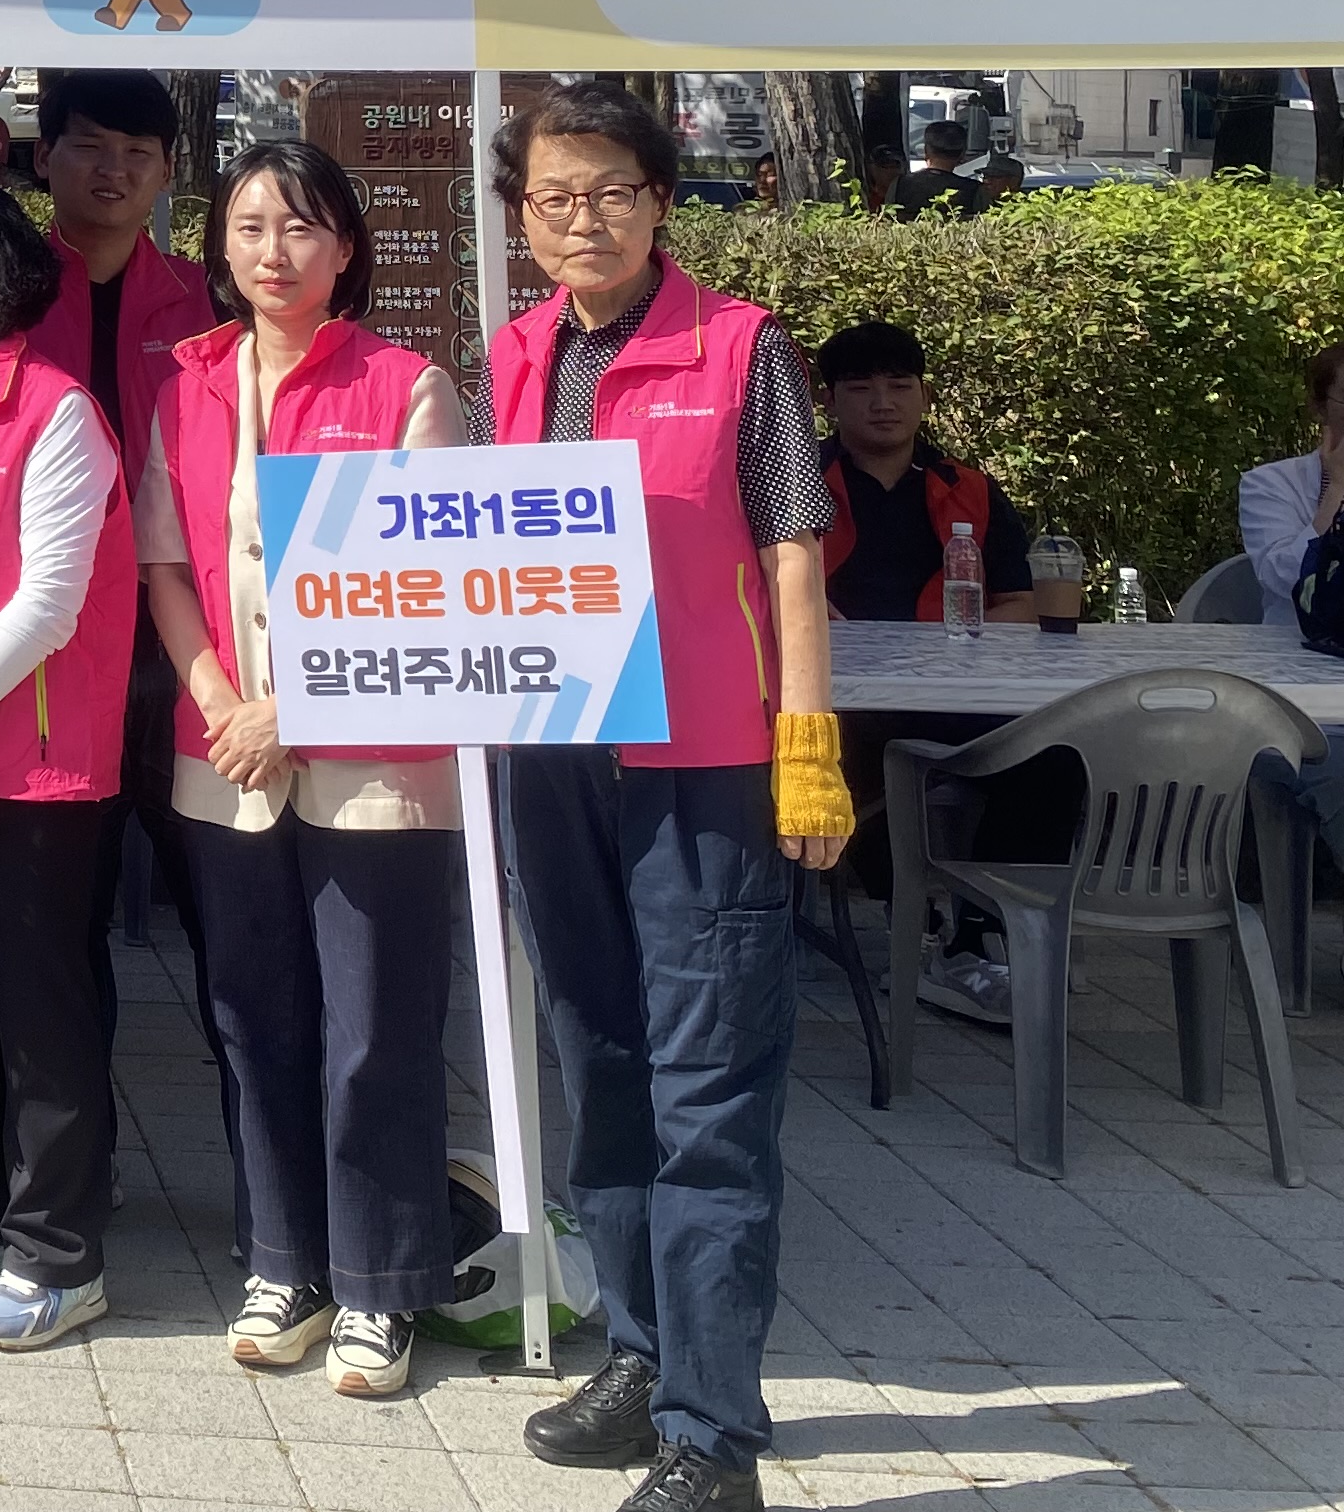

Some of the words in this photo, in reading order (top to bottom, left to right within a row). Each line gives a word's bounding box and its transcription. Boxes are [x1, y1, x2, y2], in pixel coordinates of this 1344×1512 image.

[361, 105, 430, 129] 공원내
[362, 135, 459, 160] 금지행위
[373, 185, 409, 196] 쓰레기는
[402, 197, 421, 208] 가요
[413, 299, 432, 310] 금지
[376, 485, 617, 540] 가좌1동의
[294, 568, 446, 620] 어려운
[463, 564, 623, 616] 이웃을
[301, 645, 561, 697] 알려주세요
